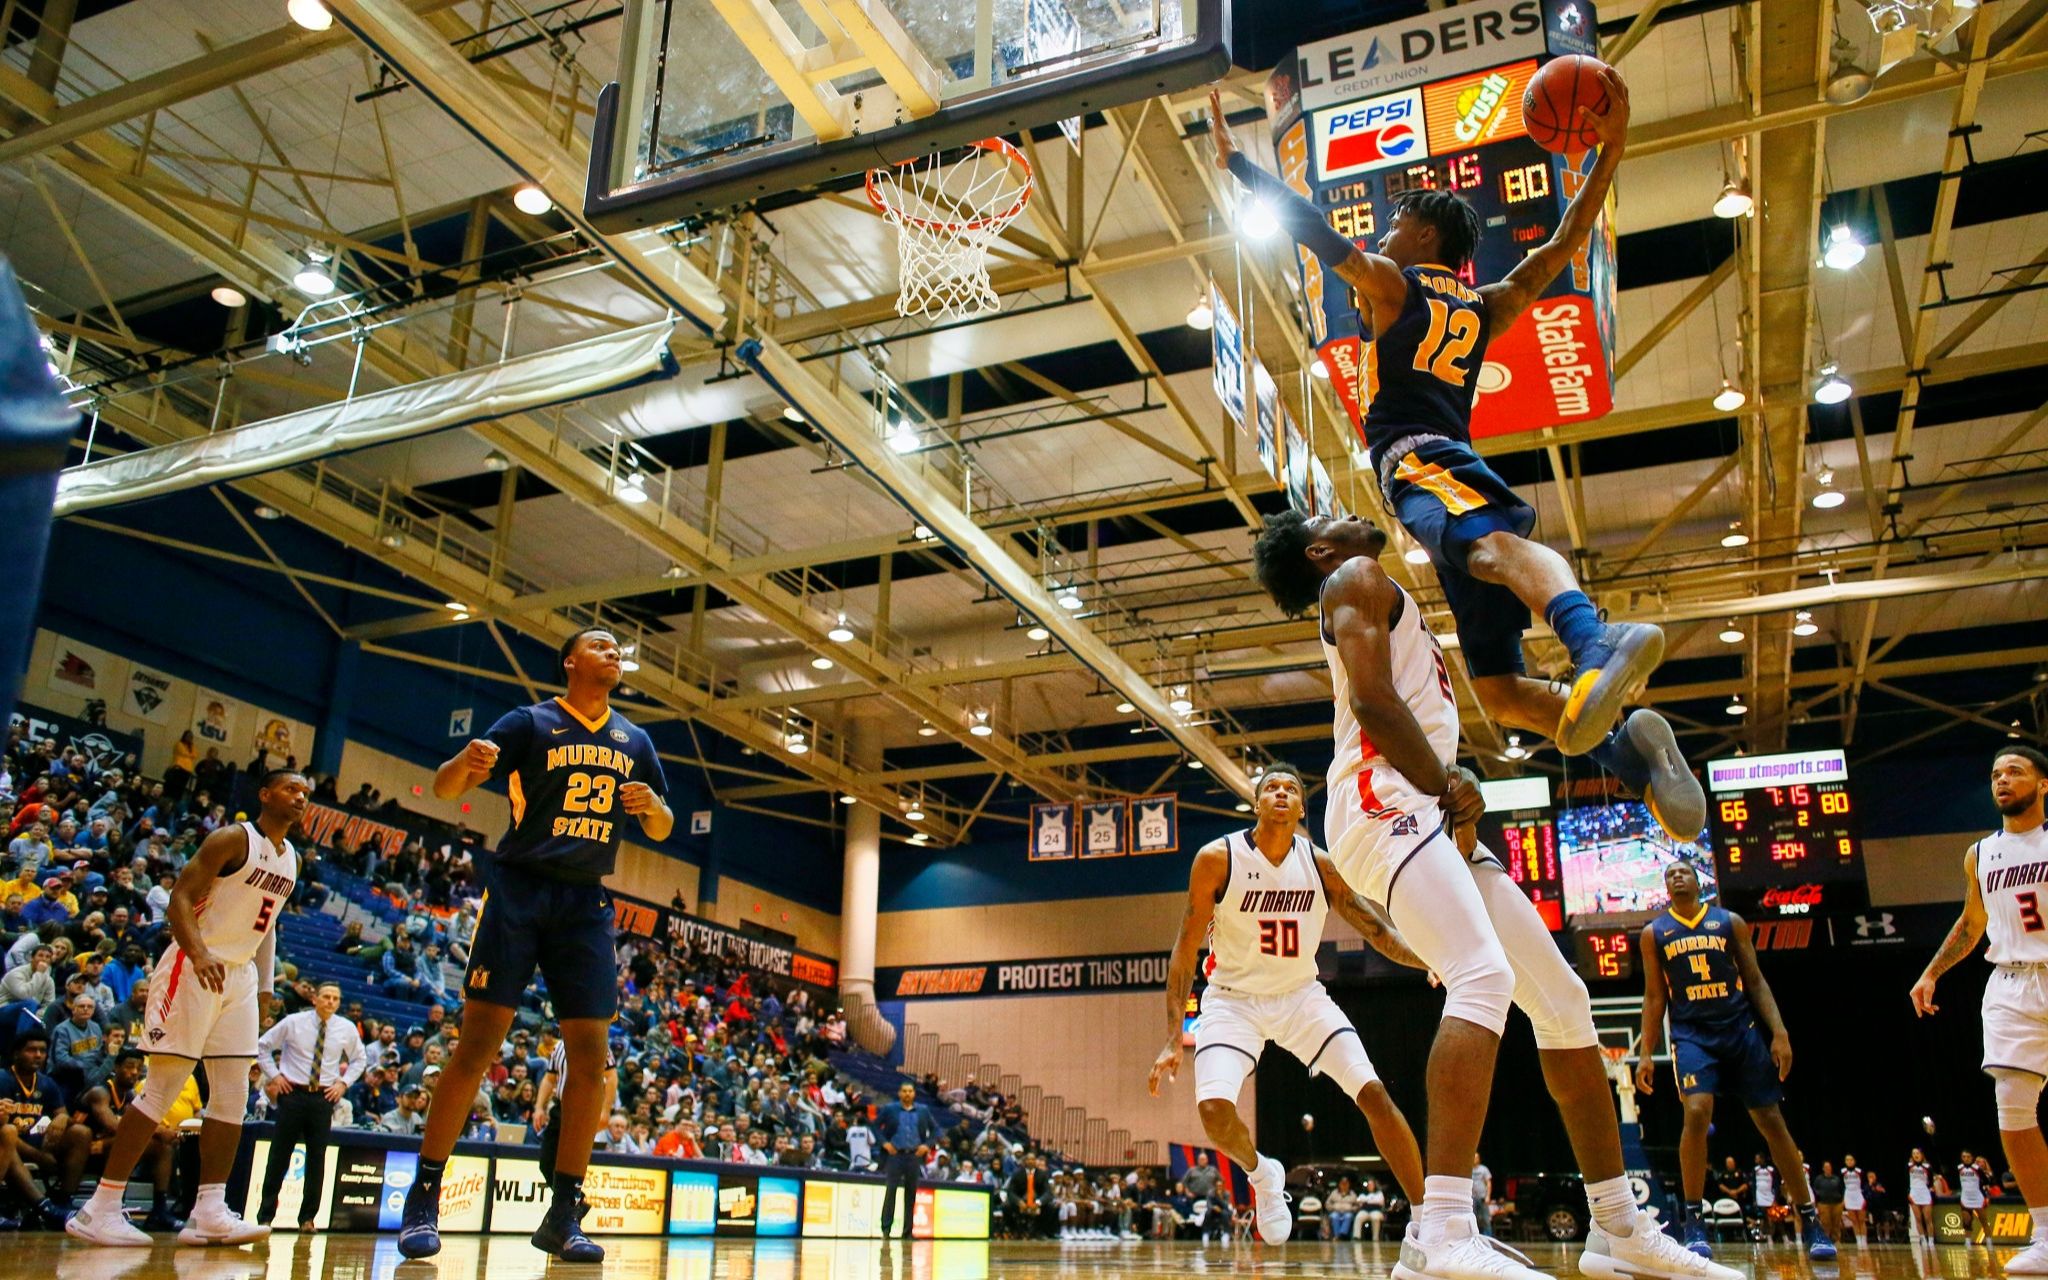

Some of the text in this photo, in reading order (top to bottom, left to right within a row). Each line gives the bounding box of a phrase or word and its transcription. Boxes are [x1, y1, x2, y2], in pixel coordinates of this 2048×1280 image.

[1300, 1, 1542, 89] LEADERS
[1334, 65, 1429, 96] CREDIT UNION
[1328, 98, 1413, 135] PEPSI
[1454, 72, 1509, 143] Crush
[1328, 182, 1366, 203] UTM
[1503, 163, 1550, 203] 80
[1332, 201, 1375, 239] 66
[1412, 297, 1481, 387] 12
[452, 717, 466, 734] K
[546, 744, 635, 780] MURRAY
[1713, 758, 1843, 783] www.utmsports.com
[562, 772, 617, 814] 23
[1765, 784, 1811, 806] 7:15
[1820, 792, 1850, 815] 80
[695, 816, 707, 831] L
[1720, 800, 1749, 823] 66
[1797, 810, 1809, 827] 2
[552, 816, 614, 844] STATE
[1044, 833, 1060, 847] 24
[1094, 831, 1111, 844] 25
[1145, 826, 1162, 840] 55
[1729, 846, 1742, 864] 2
[1838, 838, 1852, 856] 8
[244, 867, 266, 889] UT
[1986, 869, 2005, 894] UT
[1240, 889, 1316, 913] UT MARTIN
[1778, 903, 1811, 915] zero
[2014, 891, 2046, 934] 3
[253, 895, 275, 933] 5
[1257, 919, 1300, 958] 30
[1588, 935, 1628, 953] 7:15
[1663, 936, 1728, 961] MURRAY
[998, 962, 1085, 991] PROTECT
[1088, 960, 1123, 986] THIS
[1597, 953, 1619, 977] 15
[1687, 954, 1711, 982] 4
[1686, 982, 1729, 1001] STATE
[439, 1174, 485, 1208] rairie
[494, 1180, 548, 1203] WLJT
[438, 1198, 473, 1219] arms
[624, 1193, 665, 1216] Gallery
[1992, 1212, 2030, 1237] FAN
